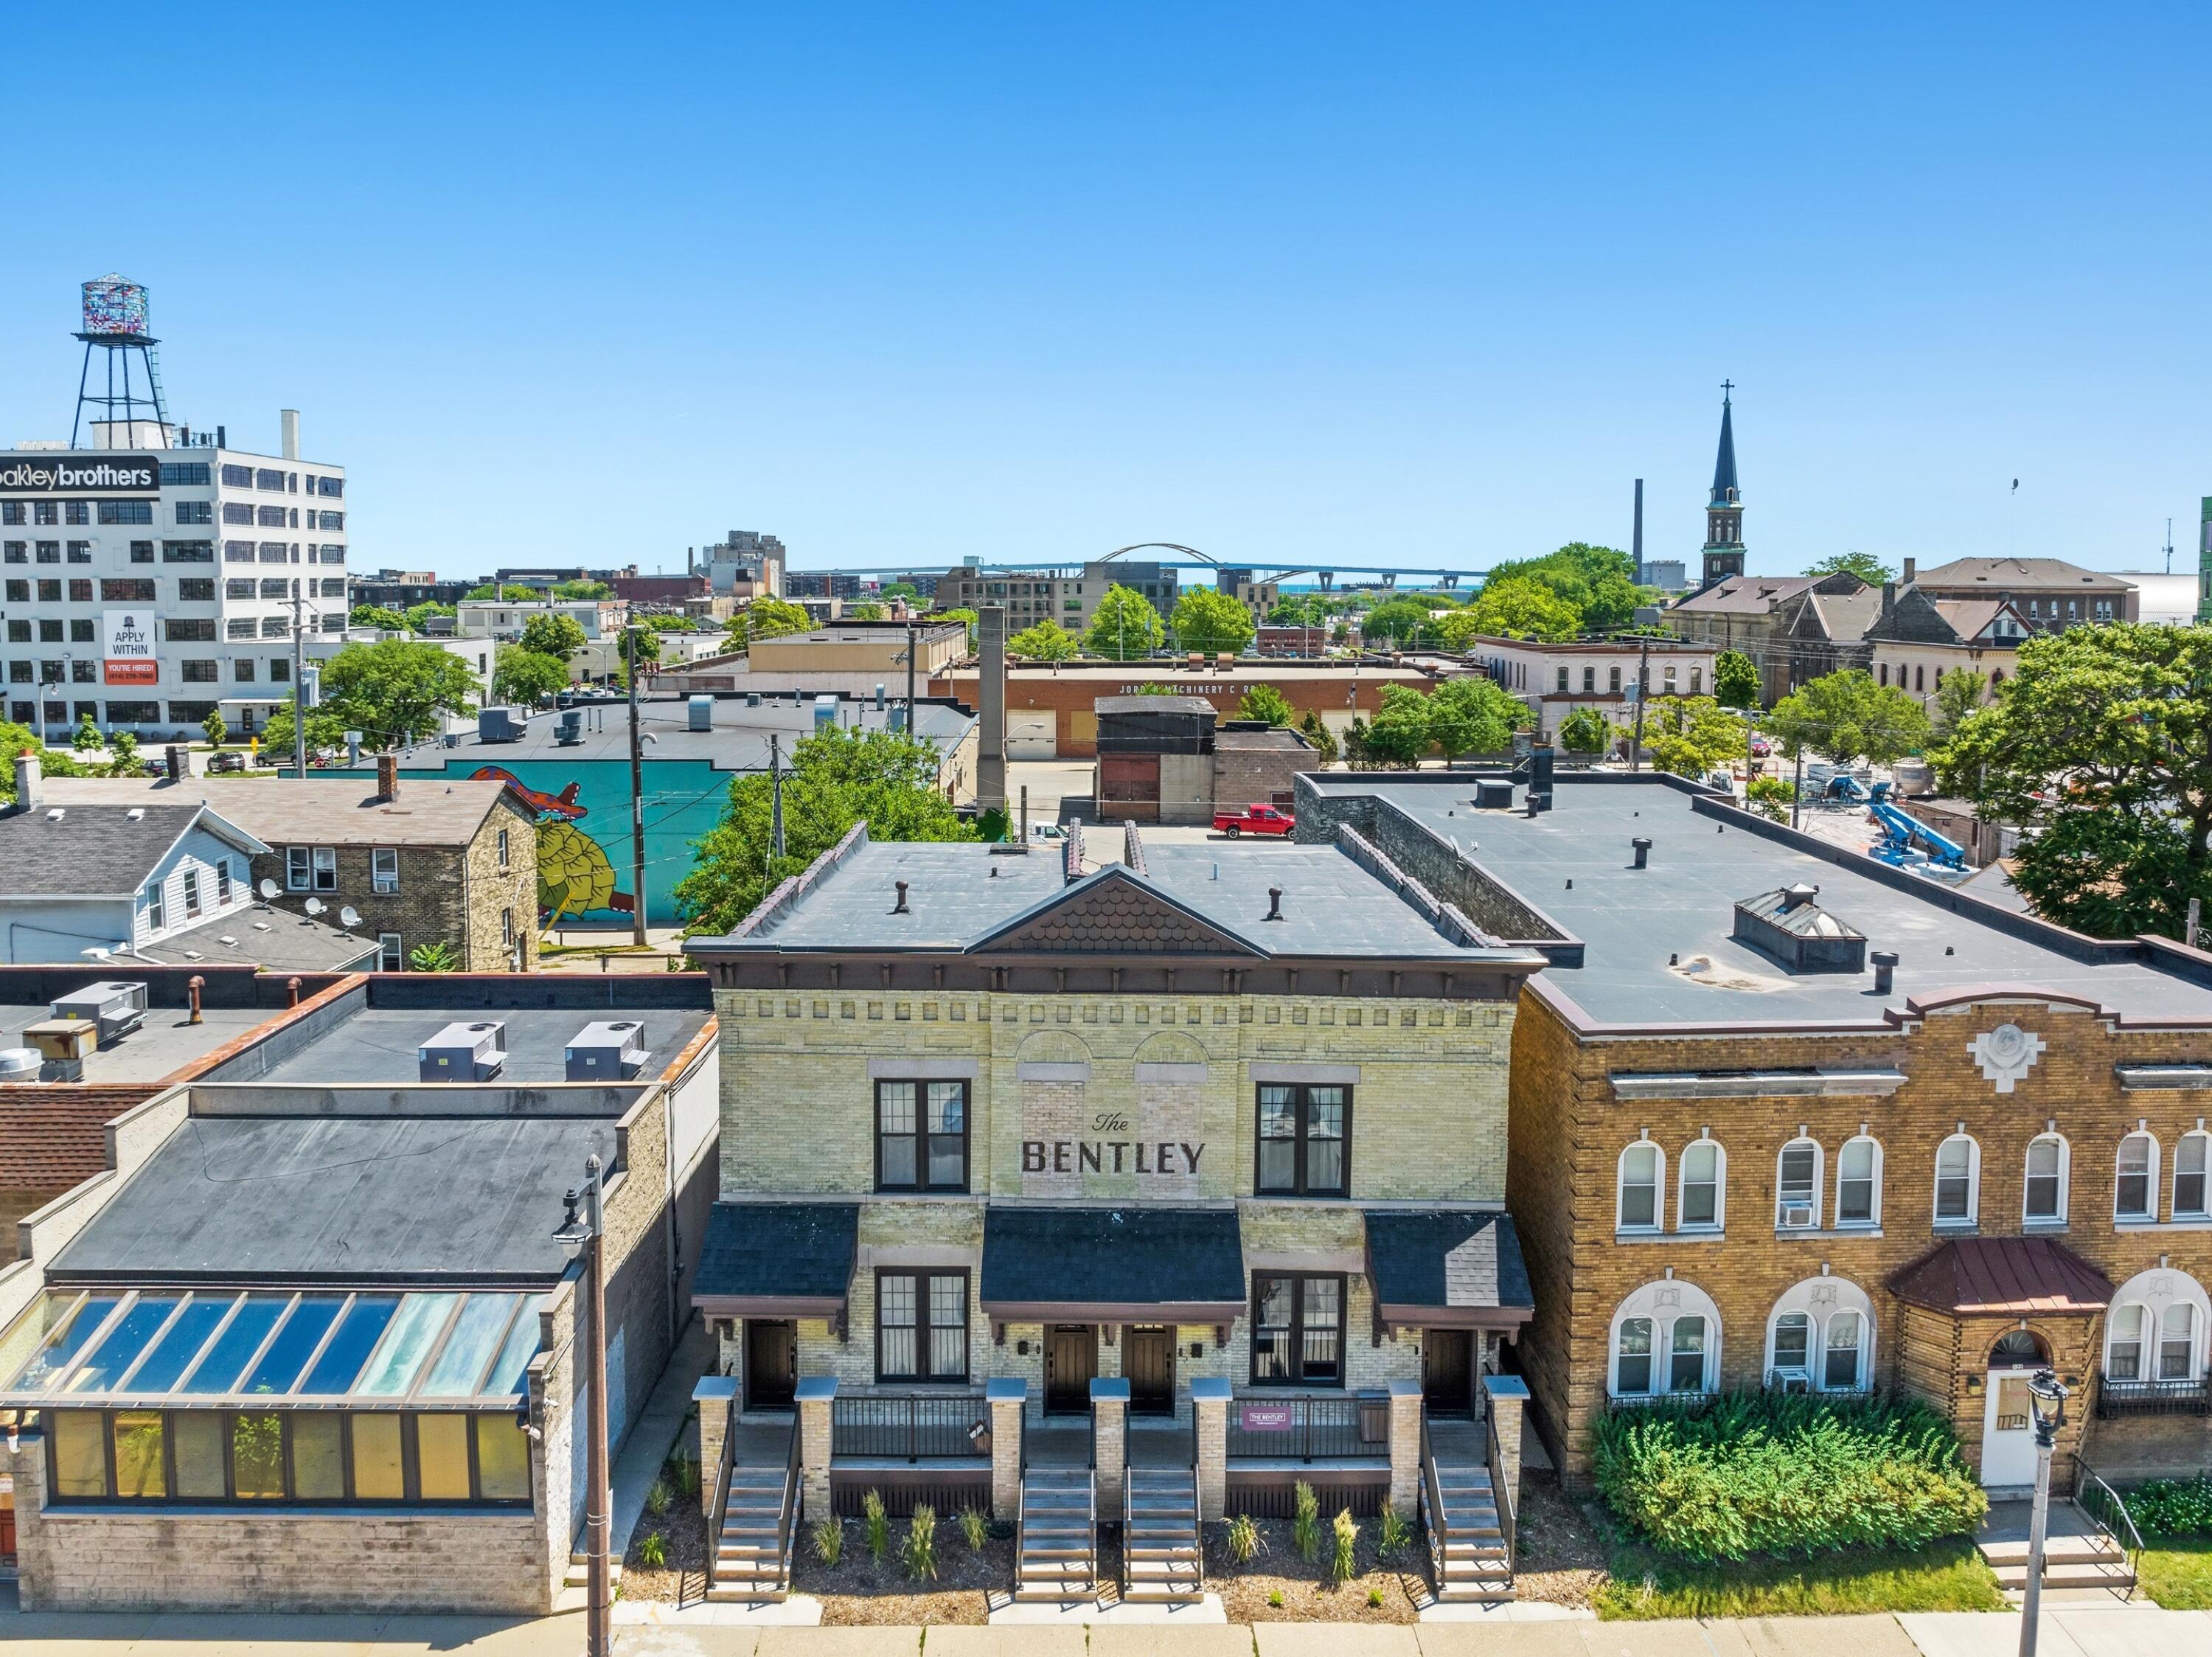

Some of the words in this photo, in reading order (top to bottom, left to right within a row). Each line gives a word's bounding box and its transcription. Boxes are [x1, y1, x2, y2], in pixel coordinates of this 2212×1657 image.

[115, 632, 145, 642] APPLY
[113, 645, 147, 655] WITHIN
[1092, 1112, 1128, 1131] The
[1023, 1141, 1206, 1174] BENTLEY
